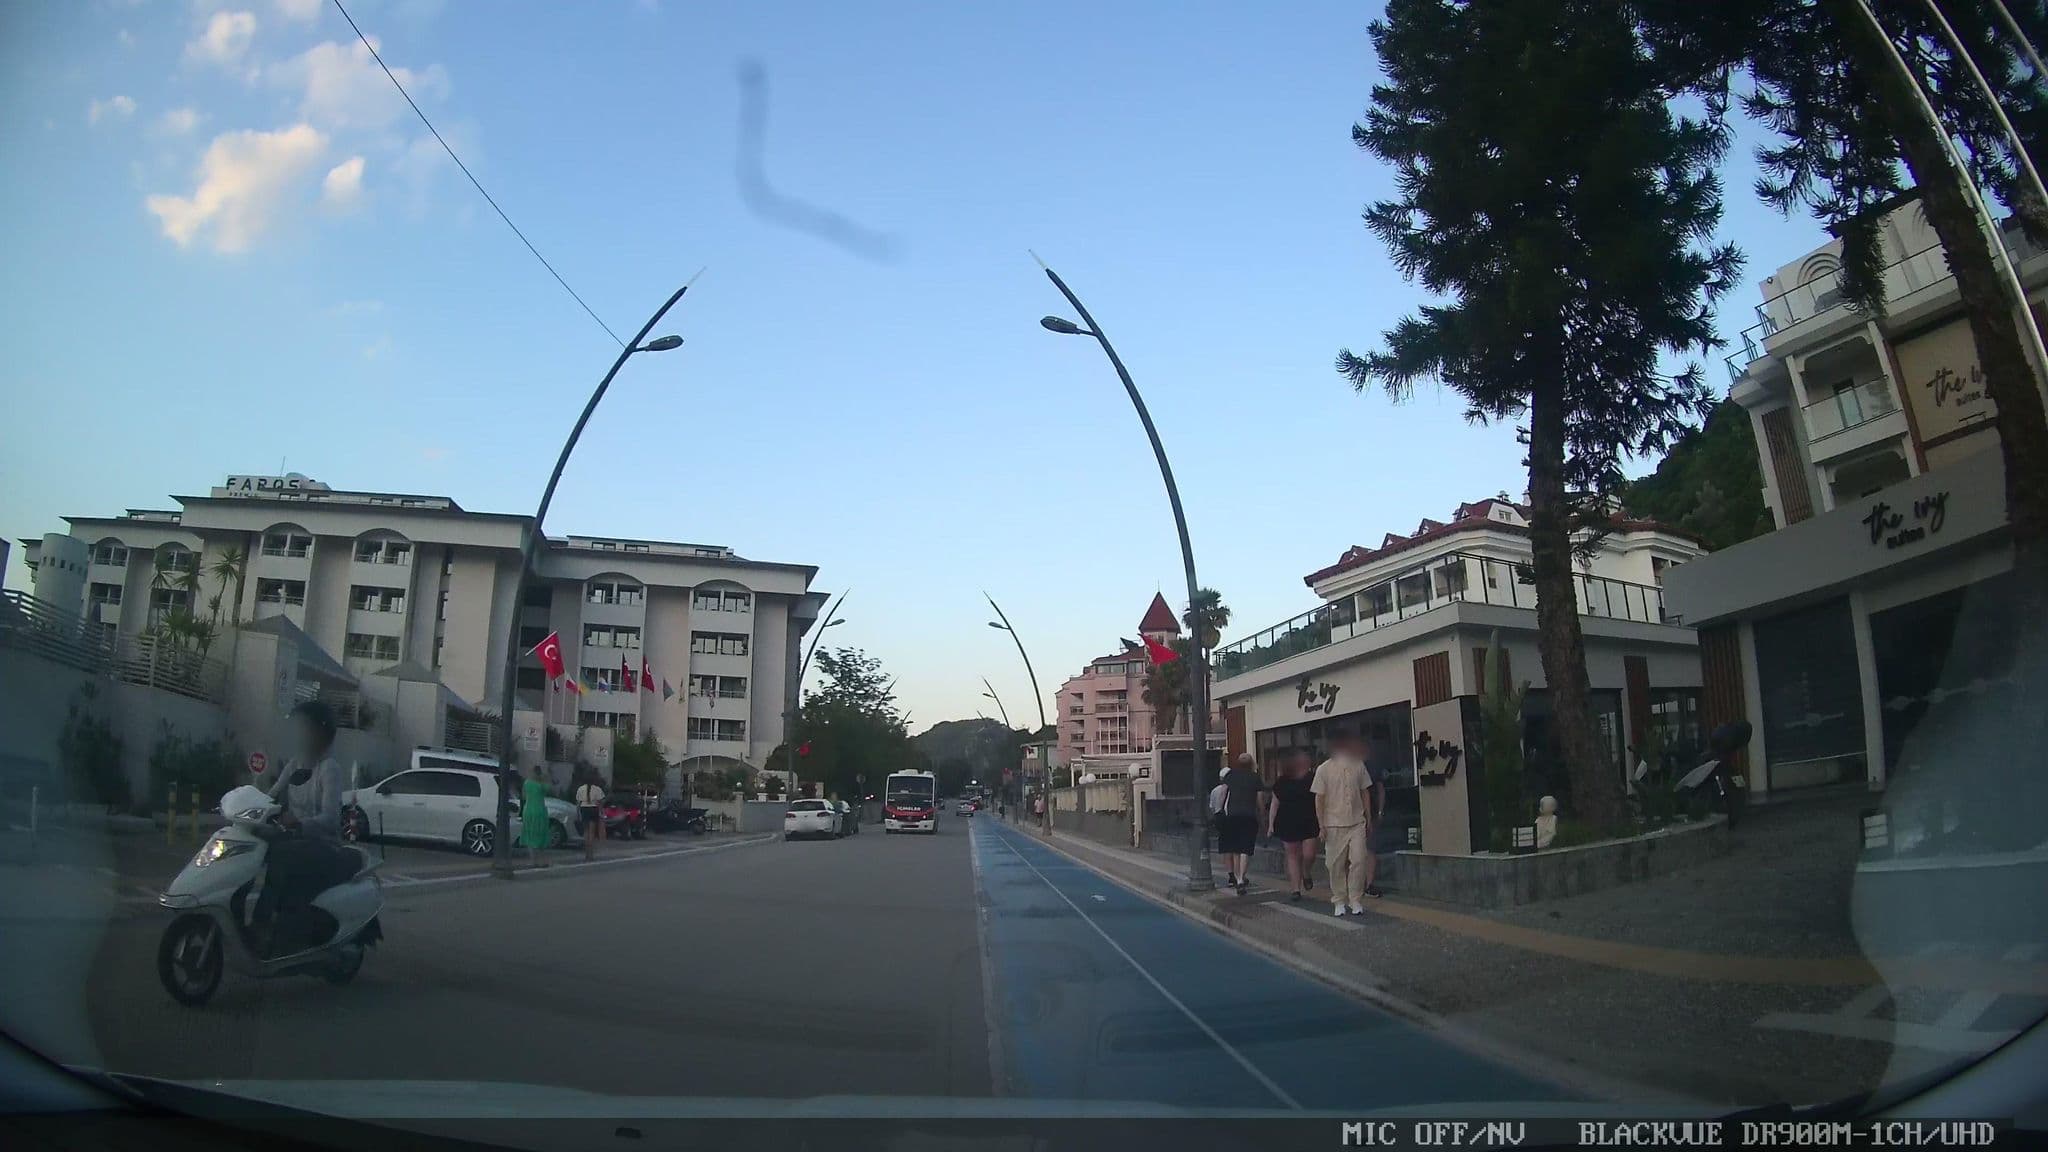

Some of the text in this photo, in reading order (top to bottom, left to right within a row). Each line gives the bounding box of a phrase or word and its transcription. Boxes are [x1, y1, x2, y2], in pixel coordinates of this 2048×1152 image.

[1926, 367, 1966, 408] the
[226, 478, 300, 491] FAROS
[1862, 491, 1950, 544] the ivy
[1296, 677, 1341, 715] the ivy
[1415, 730, 1463, 779] the ivy
